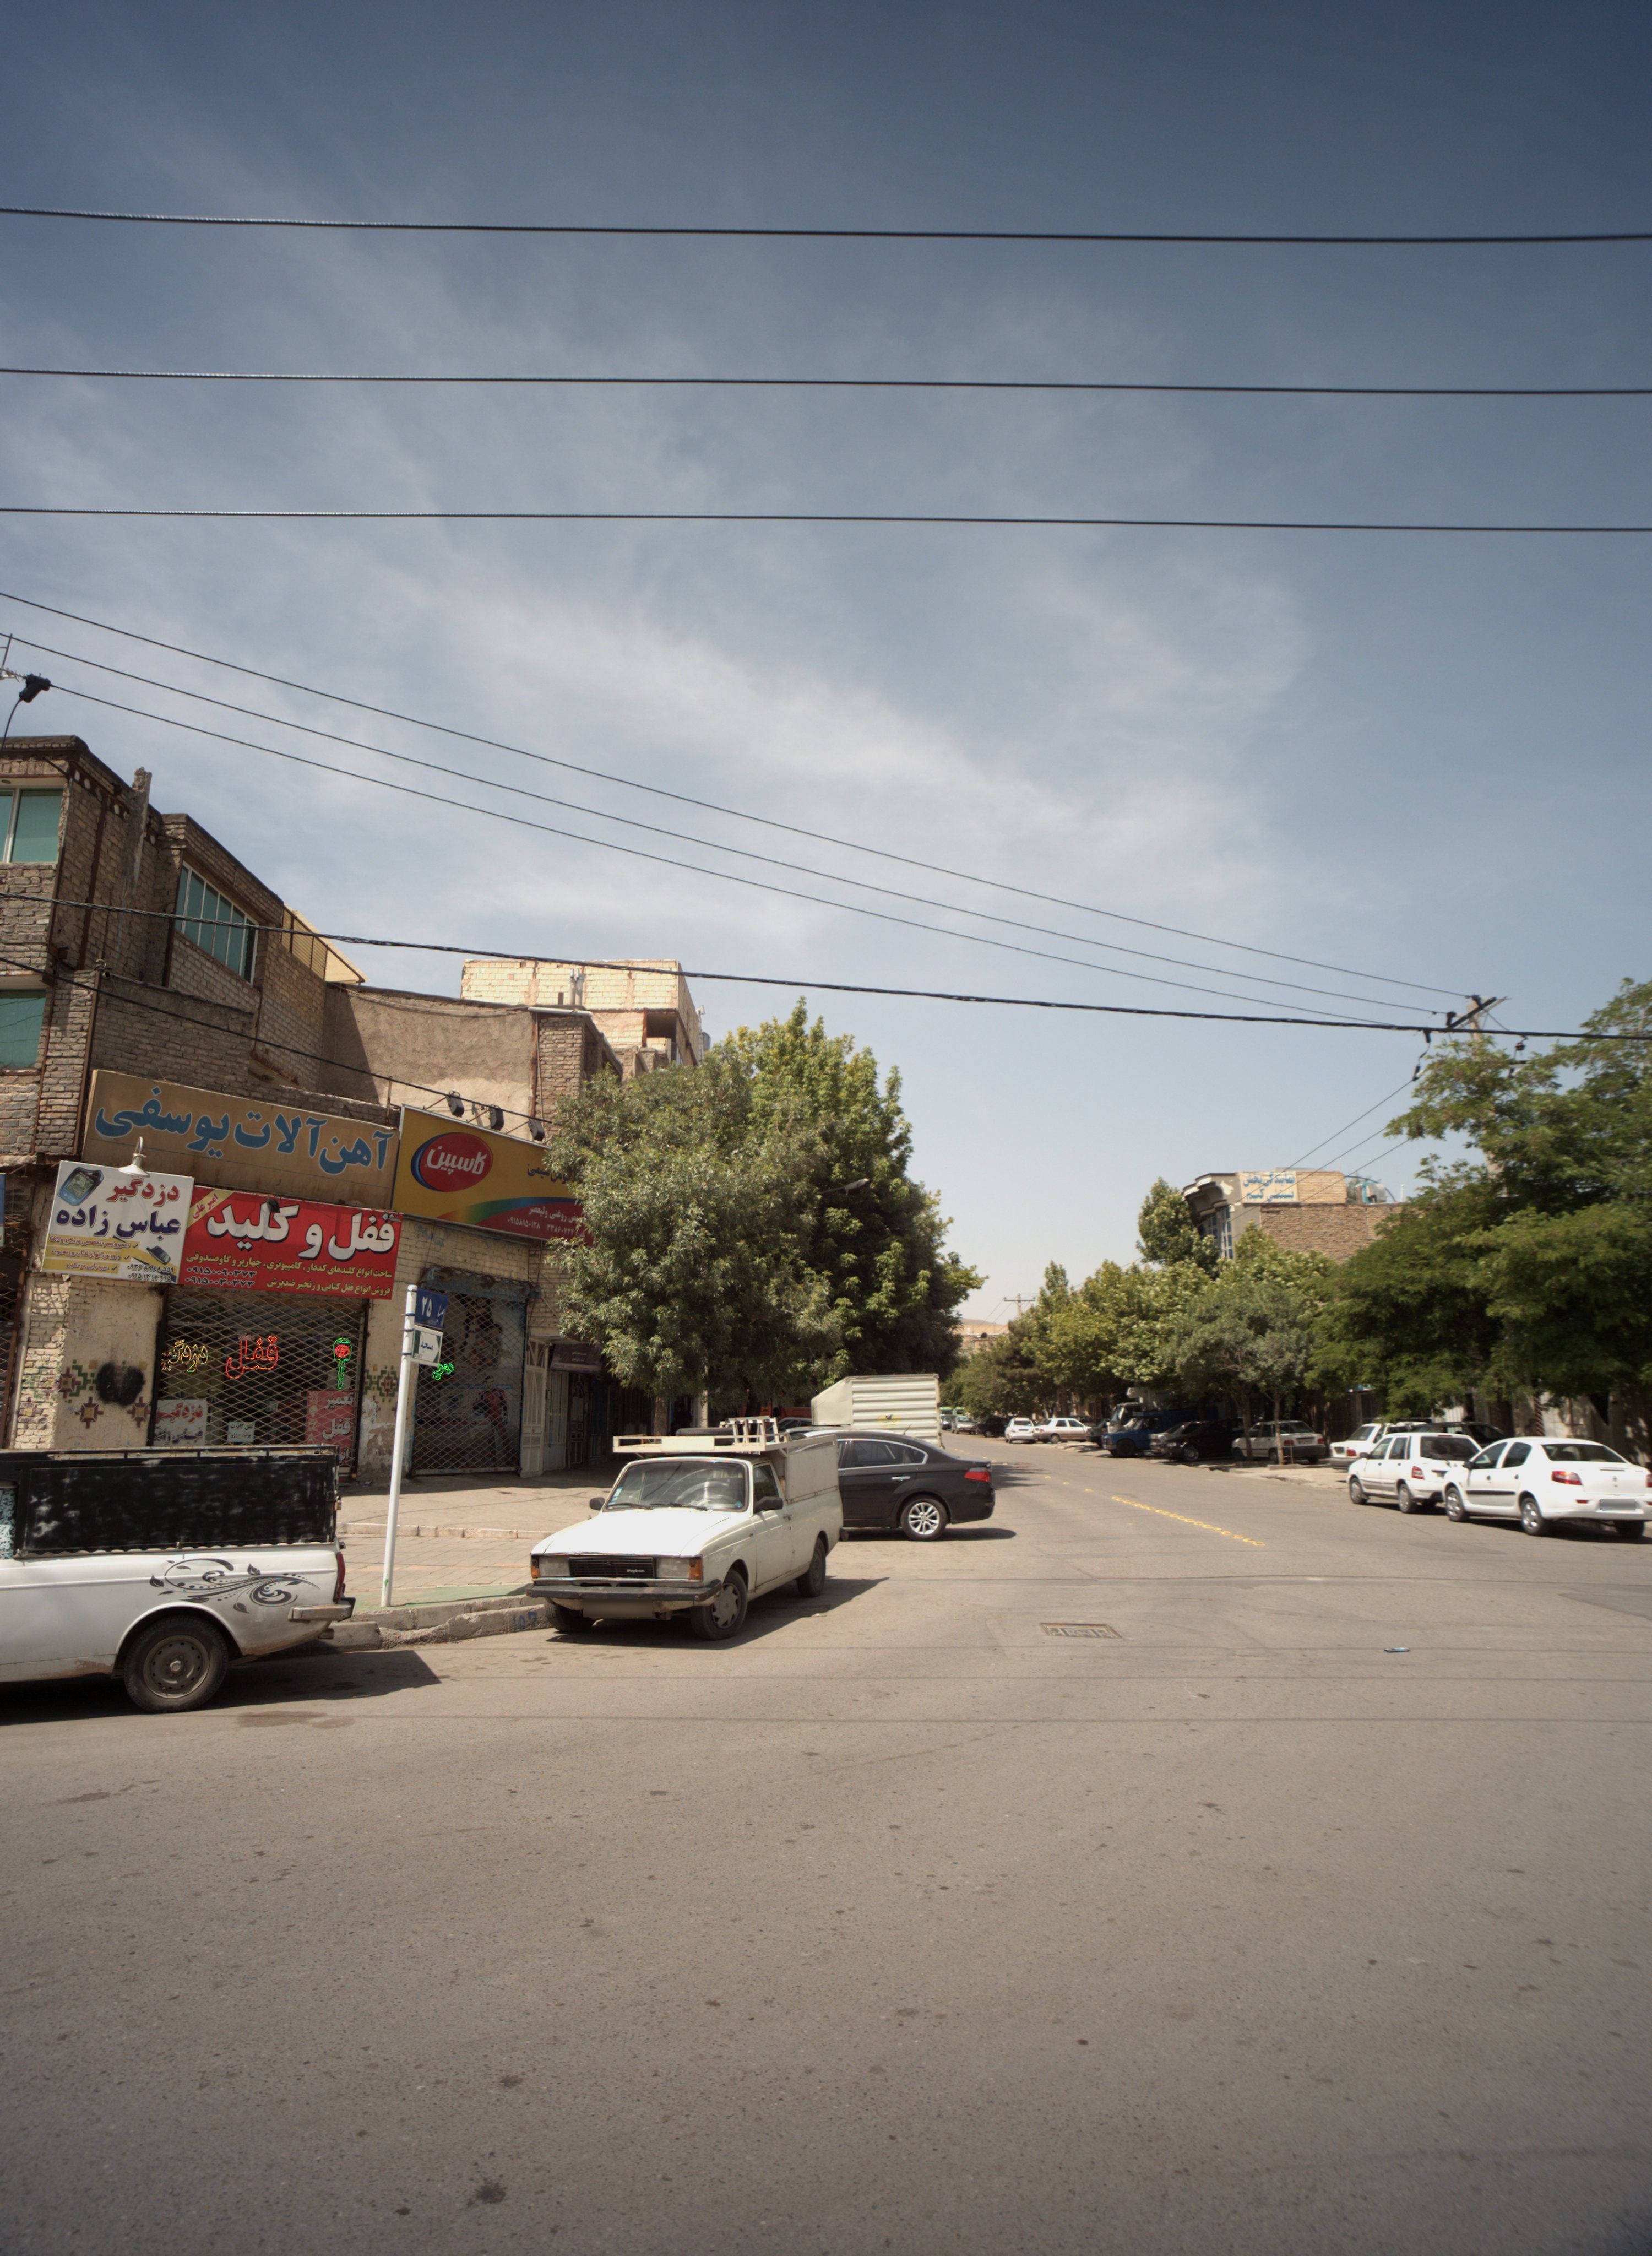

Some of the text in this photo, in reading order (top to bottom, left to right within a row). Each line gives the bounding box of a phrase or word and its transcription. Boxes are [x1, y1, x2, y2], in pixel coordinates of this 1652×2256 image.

[95, 1086, 394, 1175] آهن آلات یوسفی
[427, 1146, 487, 1175] کاسپین
[1264, 1172, 1295, 1187] نمایندگی
[106, 1178, 180, 1206] دزدگیر
[1267, 1189, 1294, 1202] بستنی
[193, 1193, 219, 1219] امیر علی
[56, 1205, 181, 1240] عباس زاده
[206, 1202, 395, 1261] قفل و کلید
[187, 1266, 257, 1277] ۰۹۱۵۰۰۹۰۳۷۳
[266, 1260, 302, 1271] کامپیوتری
[327, 1266, 356, 1276] کلیدهای
[356, 1268, 373, 1278] انواع
[373, 1270, 392, 1278] ساخت
[185, 1276, 255, 1287] ۰۹۱۵۰۰۳۰۳۷۳
[296, 1280, 316, 1290] زنجیر
[321, 1283, 341, 1292] کتابی
[341, 1283, 354, 1293] قفل
[354, 1286, 371, 1295] انواع
[371, 1287, 390, 1296] فروش
[422, 1296, 432, 1317] ۲۵
[225, 1335, 278, 1379] قفل
[323, 1392, 354, 1409] تعمیر
[322, 1417, 351, 1440] قفل
